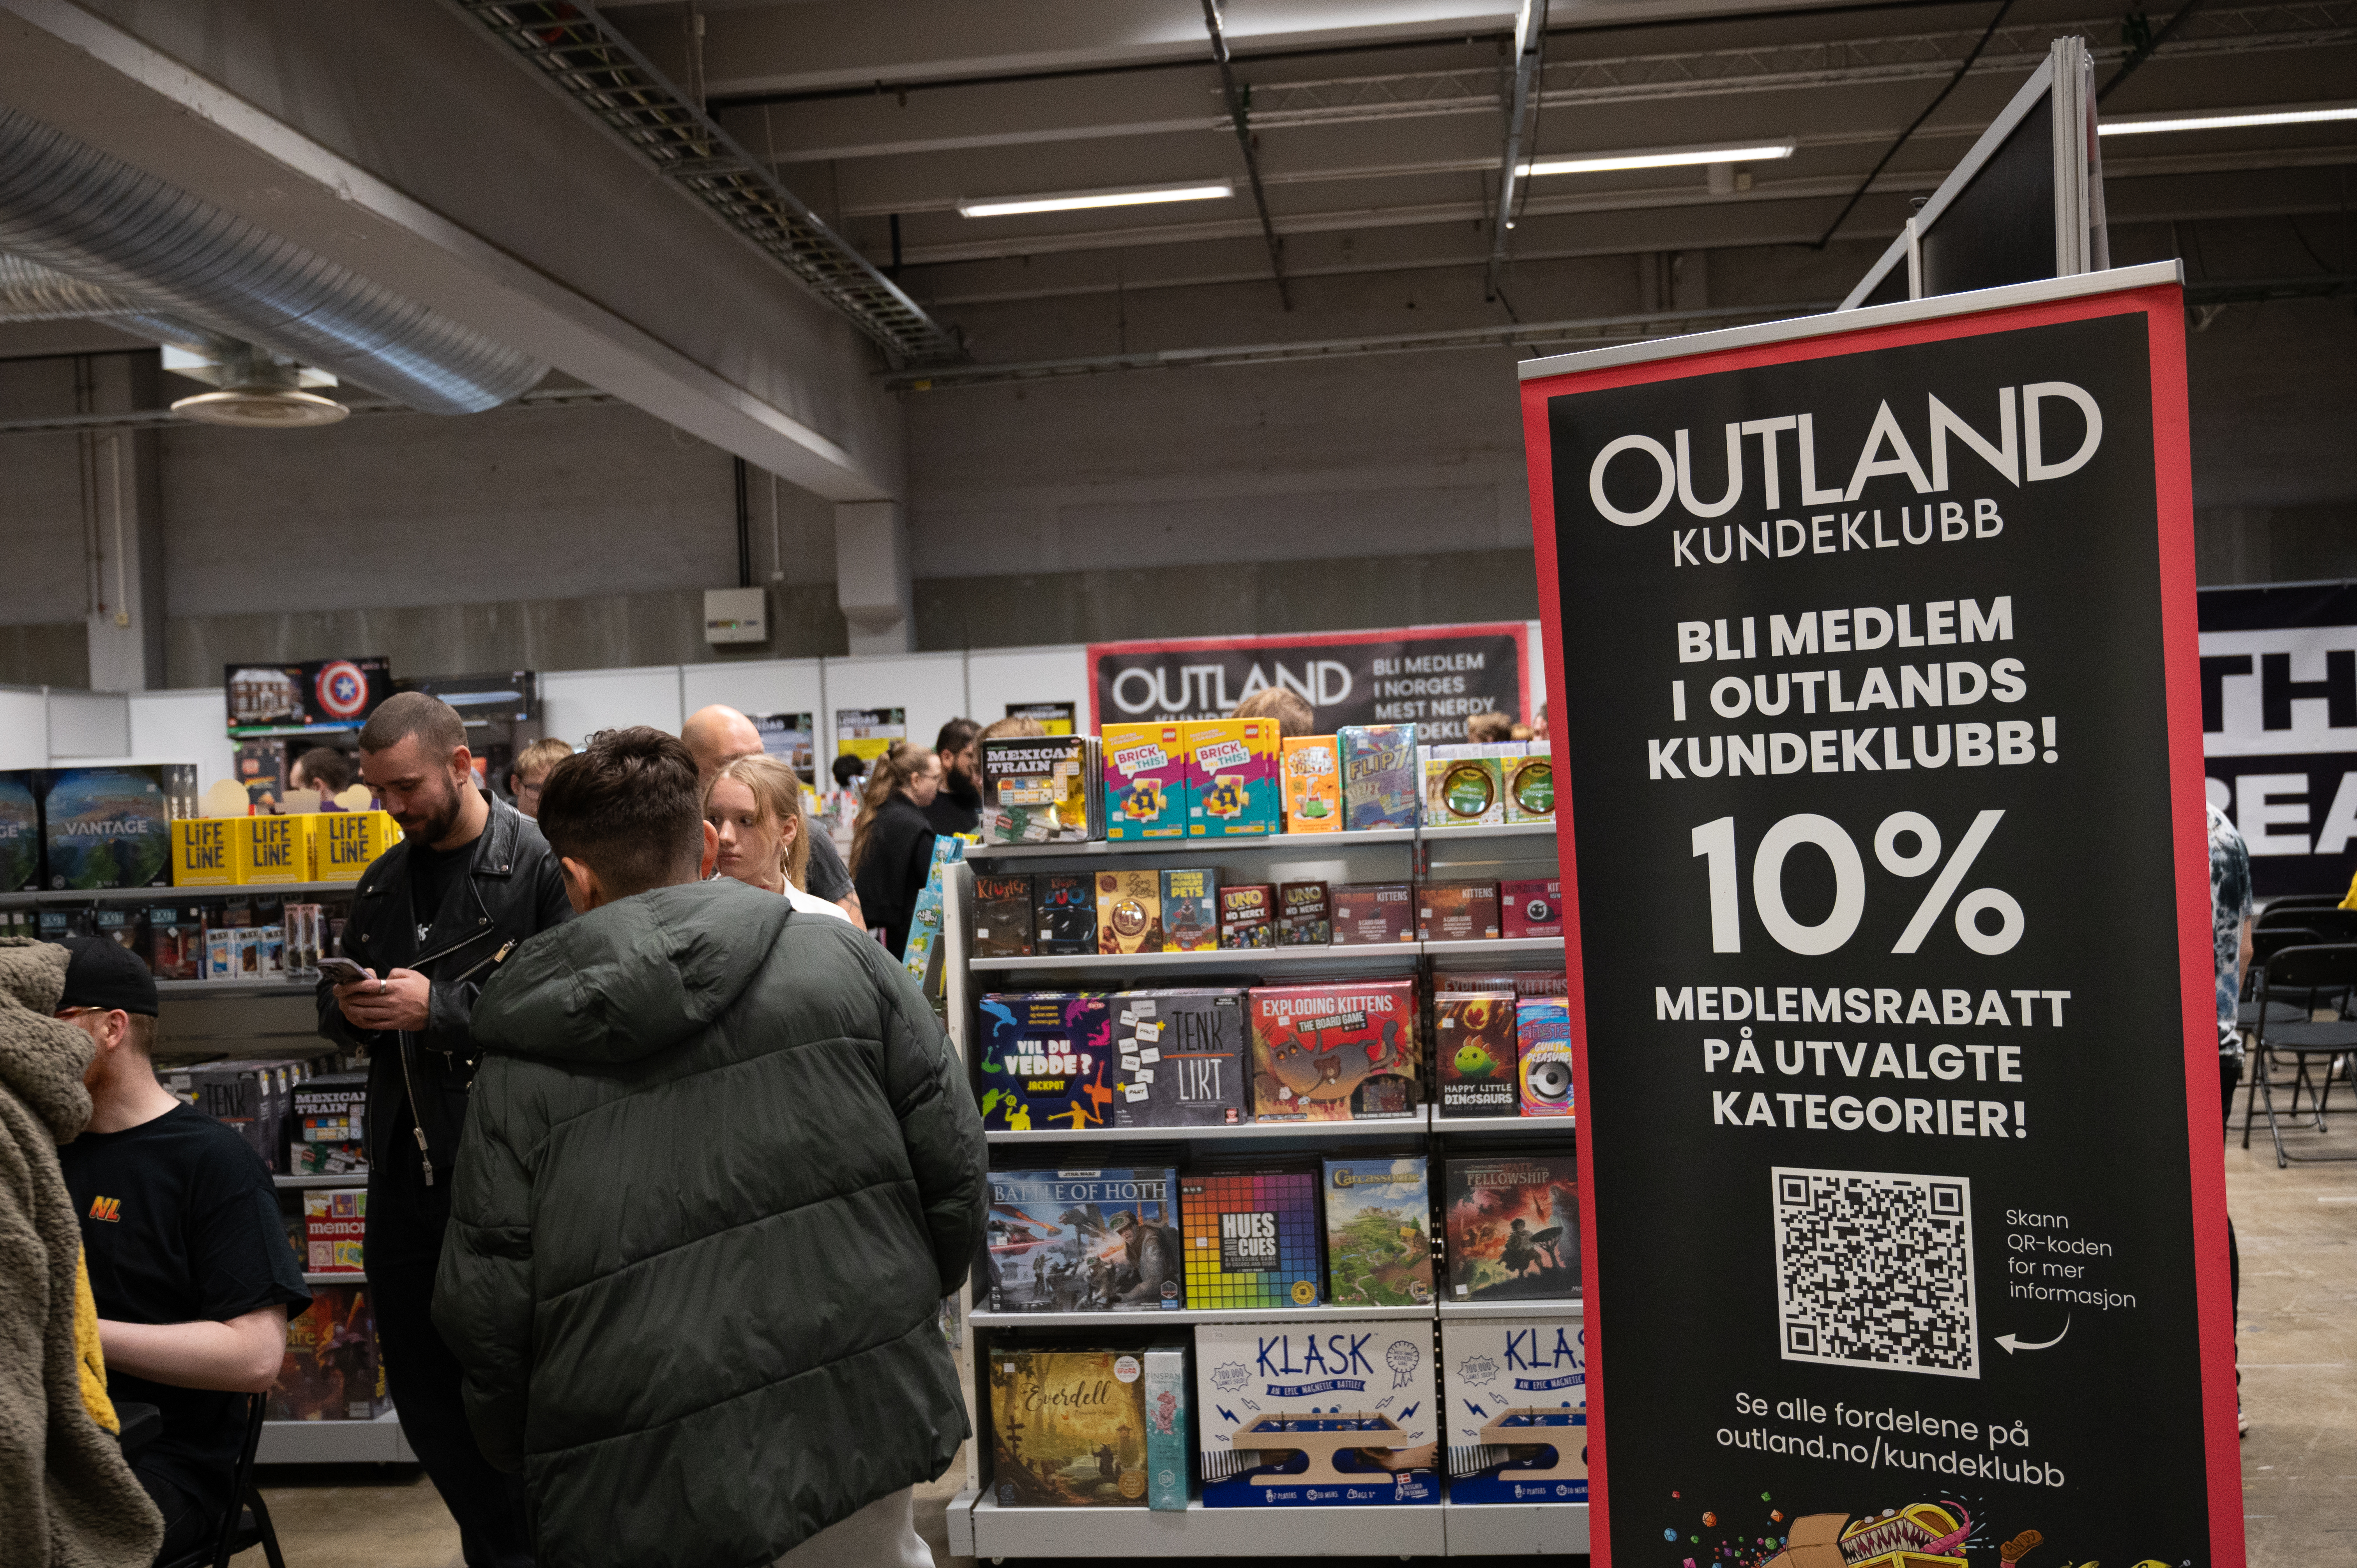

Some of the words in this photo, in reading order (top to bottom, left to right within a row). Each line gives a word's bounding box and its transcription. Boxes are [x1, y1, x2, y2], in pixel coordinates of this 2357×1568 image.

[1590, 381, 2102, 526] OUTLAND
[1673, 498, 2003, 567] KUNDEKLUBB
[1678, 617, 1756, 663] BLI
[1770, 596, 2013, 656] MEDLEM
[1373, 658, 1400, 676] BLI
[1405, 652, 1484, 674] MEDLEM
[1374, 682, 1380, 697] I
[1385, 676, 1465, 697] NORGES
[1672, 680, 1686, 721] I
[1710, 658, 2026, 718] OUTLANDS
[1375, 700, 1426, 719] MEST
[1432, 697, 1495, 716] NERDY
[987, 747, 1080, 761] MEXICAN
[1118, 747, 1157, 764] BRICK
[1200, 743, 1239, 761] BRICK
[1648, 717, 2058, 779] KUNDEKLUBB!
[987, 761, 1051, 773] TRAIN
[1136, 756, 1165, 769] THIS!
[1218, 752, 1247, 766] THIS!
[1350, 751, 1395, 780] FLIP
[65, 820, 147, 835] VANTAGE
[1171, 886, 1204, 898] PETS
[1692, 810, 2024, 955] 10%
[1224, 889, 1263, 909] UNO
[1285, 886, 1322, 905] UNO
[1376, 890, 1408, 902] KITTENS
[1462, 888, 1493, 898] KITTENS
[1226, 911, 1239, 921] NO
[1239, 908, 1265, 919] MERCY
[1286, 906, 1298, 916] NO
[1299, 902, 1324, 913] MERCY
[1263, 998, 1335, 1016] EXPLODING
[1338, 995, 1393, 1014] KITTENS
[1656, 987, 2071, 1027] MEDLEMSRABATT
[1171, 1011, 1223, 1051] TENK
[1299, 1021, 1315, 1032] THE
[1315, 1016, 1341, 1029] BOARD
[1342, 1012, 1364, 1023] GAME
[1522, 1023, 1571, 1039] HITSTE
[1017, 1040, 1044, 1054] VIL
[1048, 1040, 1071, 1054] DU
[1535, 1041, 1567, 1051] GUILTY
[1704, 1026, 1764, 1073] PÅ
[1776, 1040, 2022, 1082] UTVALGTE
[1027, 1081, 1065, 1091] JACKPOT
[1178, 1058, 1222, 1100] LIKT
[1444, 1084, 1475, 1093] HAPPY
[1480, 1083, 1512, 1092] LITTLE
[295, 1104, 348, 1114] TRAIN
[1444, 1093, 1512, 1105] DINOSAURS
[1713, 1091, 2026, 1138] KATEGORIER!
[1334, 1169, 1420, 1186] Carcassonne
[1467, 1171, 1550, 1186] FELLOWSHIP
[994, 1184, 1064, 1202] BATTLE
[1071, 1184, 1098, 1200] OF
[1105, 1183, 1167, 1199] HOTH
[89, 1195, 121, 1222] NL
[1223, 1213, 1276, 1238] HUES
[2007, 1210, 2068, 1228] Skann
[1239, 1238, 1276, 1257] CUES
[2008, 1234, 2111, 1256] QR-koden
[2009, 1257, 2035, 1274] for
[2043, 1264, 2084, 1278] mer
[2011, 1281, 2135, 1310] informasjon
[1256, 1332, 1374, 1377] KLASK
[1504, 1328, 1585, 1371] KLA
[1270, 1386, 1280, 1395] AN
[1285, 1386, 1299, 1395] EPIC
[1302, 1381, 1334, 1394] MAGNETIC
[1337, 1381, 1362, 1390] BATTLE!
[1519, 1381, 1529, 1389] AN
[1533, 1380, 1548, 1389] EPIC
[1551, 1376, 1583, 1388] MAGNETIC
[1020, 1380, 1112, 1412] Everdell
[1736, 1393, 1767, 1416] Se
[1777, 1398, 1826, 1423] alle
[1835, 1402, 1978, 1440] fordelene
[1989, 1420, 2028, 1450] på
[1717, 1427, 2064, 1487] outland.no/kundeklubb
[2004, 1531, 2036, 1553] ANDY
